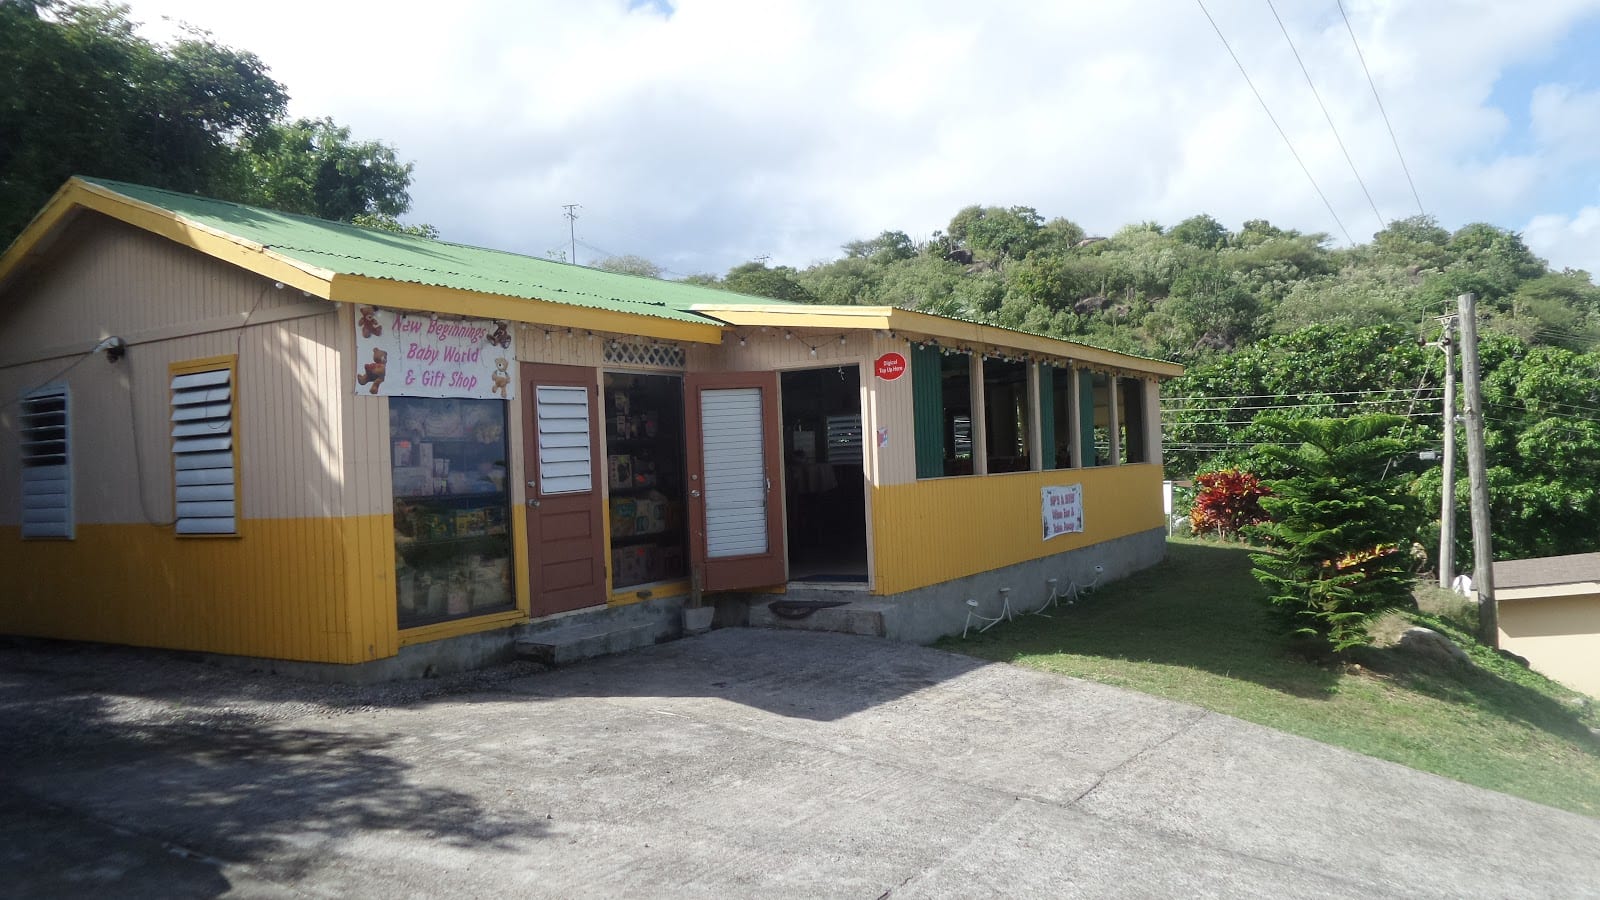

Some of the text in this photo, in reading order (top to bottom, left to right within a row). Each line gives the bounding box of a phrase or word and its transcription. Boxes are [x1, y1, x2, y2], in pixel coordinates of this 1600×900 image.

[392, 315, 487, 343] New Beginnings
[407, 343, 480, 366] Baby World
[405, 370, 477, 391] & Gift Shop
